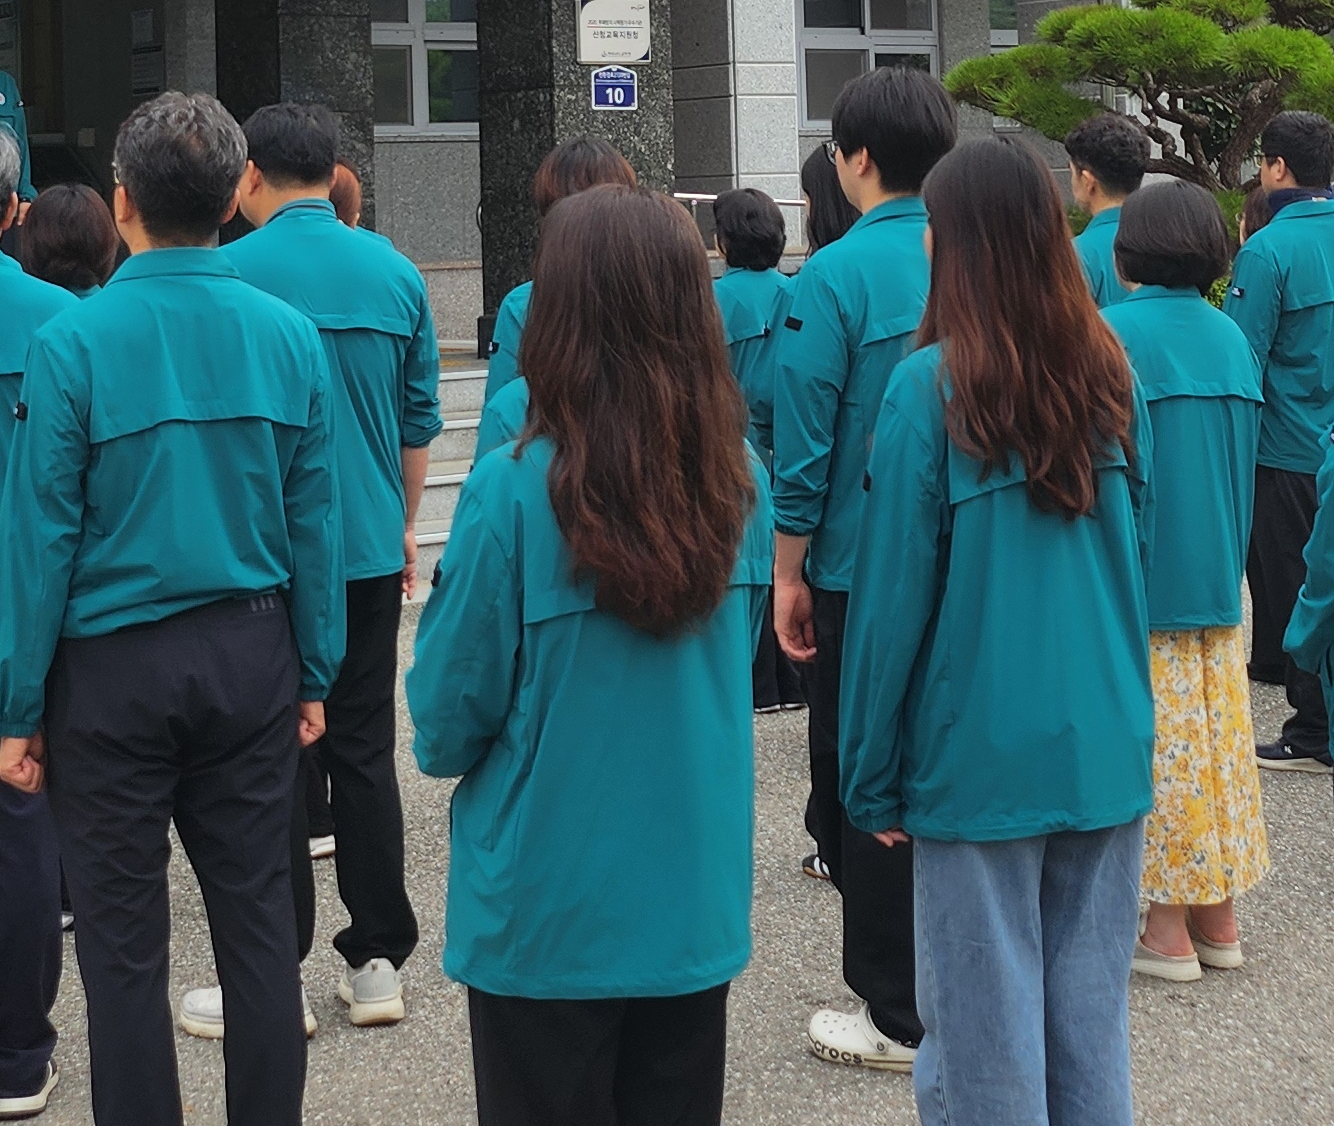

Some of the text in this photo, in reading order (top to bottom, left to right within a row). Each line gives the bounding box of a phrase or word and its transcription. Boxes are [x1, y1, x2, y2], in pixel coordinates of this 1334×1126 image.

[592, 30, 639, 39] 산청교육지원청
[605, 87, 624, 104] 10
[814, 1040, 862, 1064] crocs
